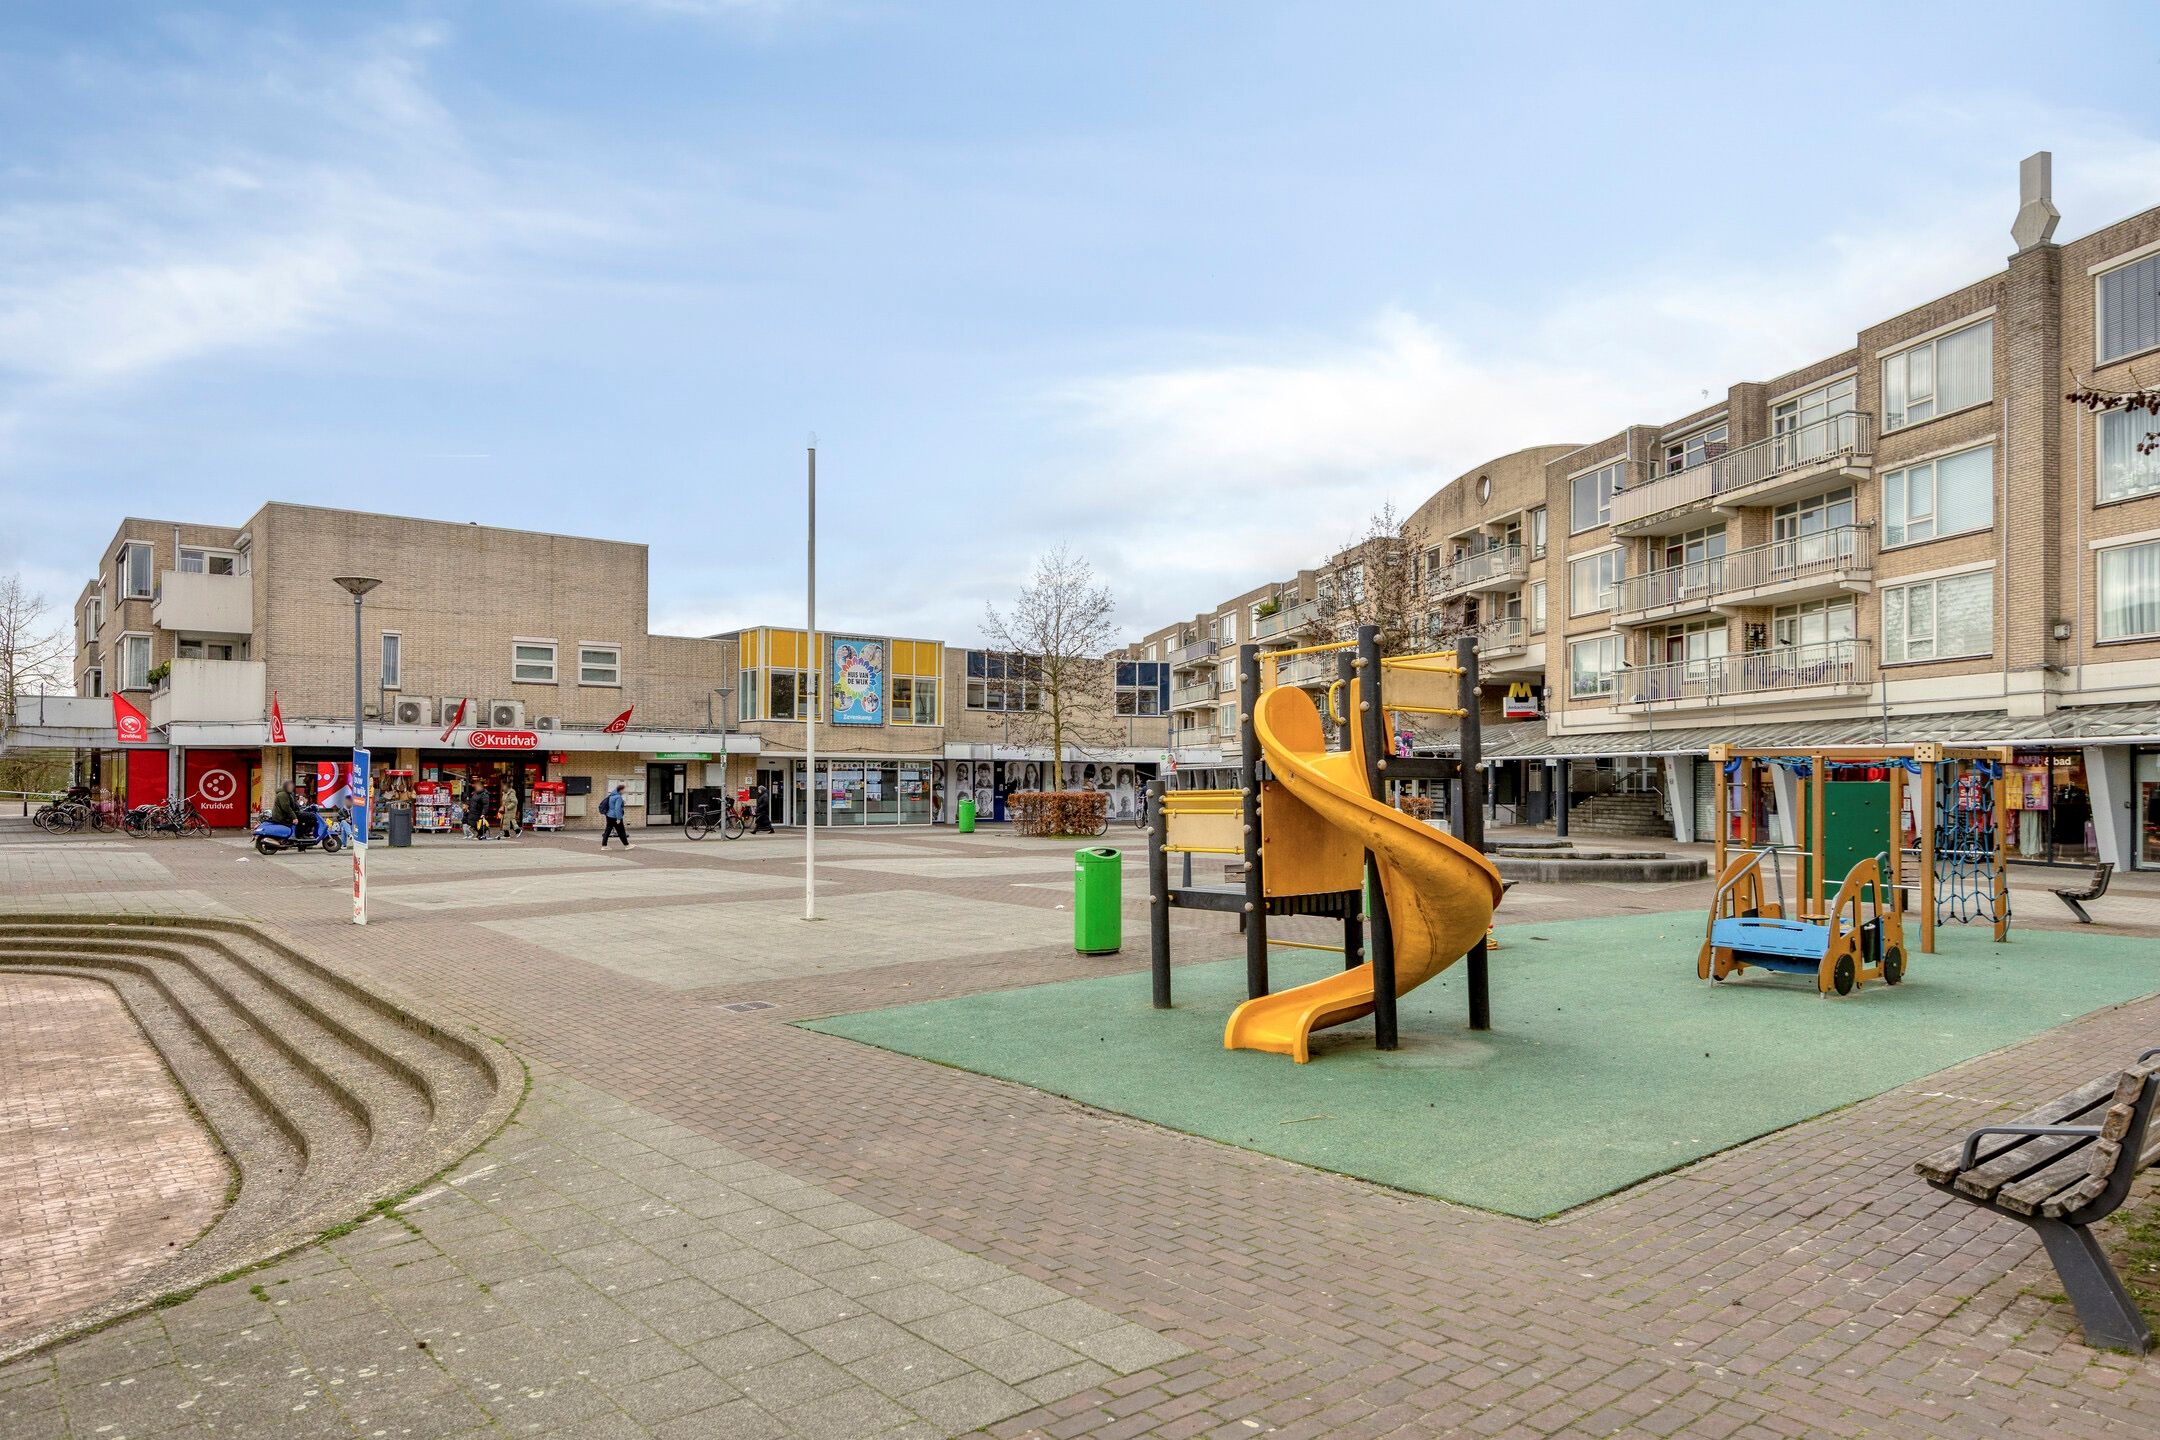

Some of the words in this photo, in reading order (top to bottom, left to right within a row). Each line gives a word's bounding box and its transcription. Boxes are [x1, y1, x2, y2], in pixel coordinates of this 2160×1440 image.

[847, 671, 858, 679] HUIS
[487, 734, 536, 746] Kruidvat
[2053, 756, 2071, 766] bad
[200, 802, 234, 810] Kruidvat
